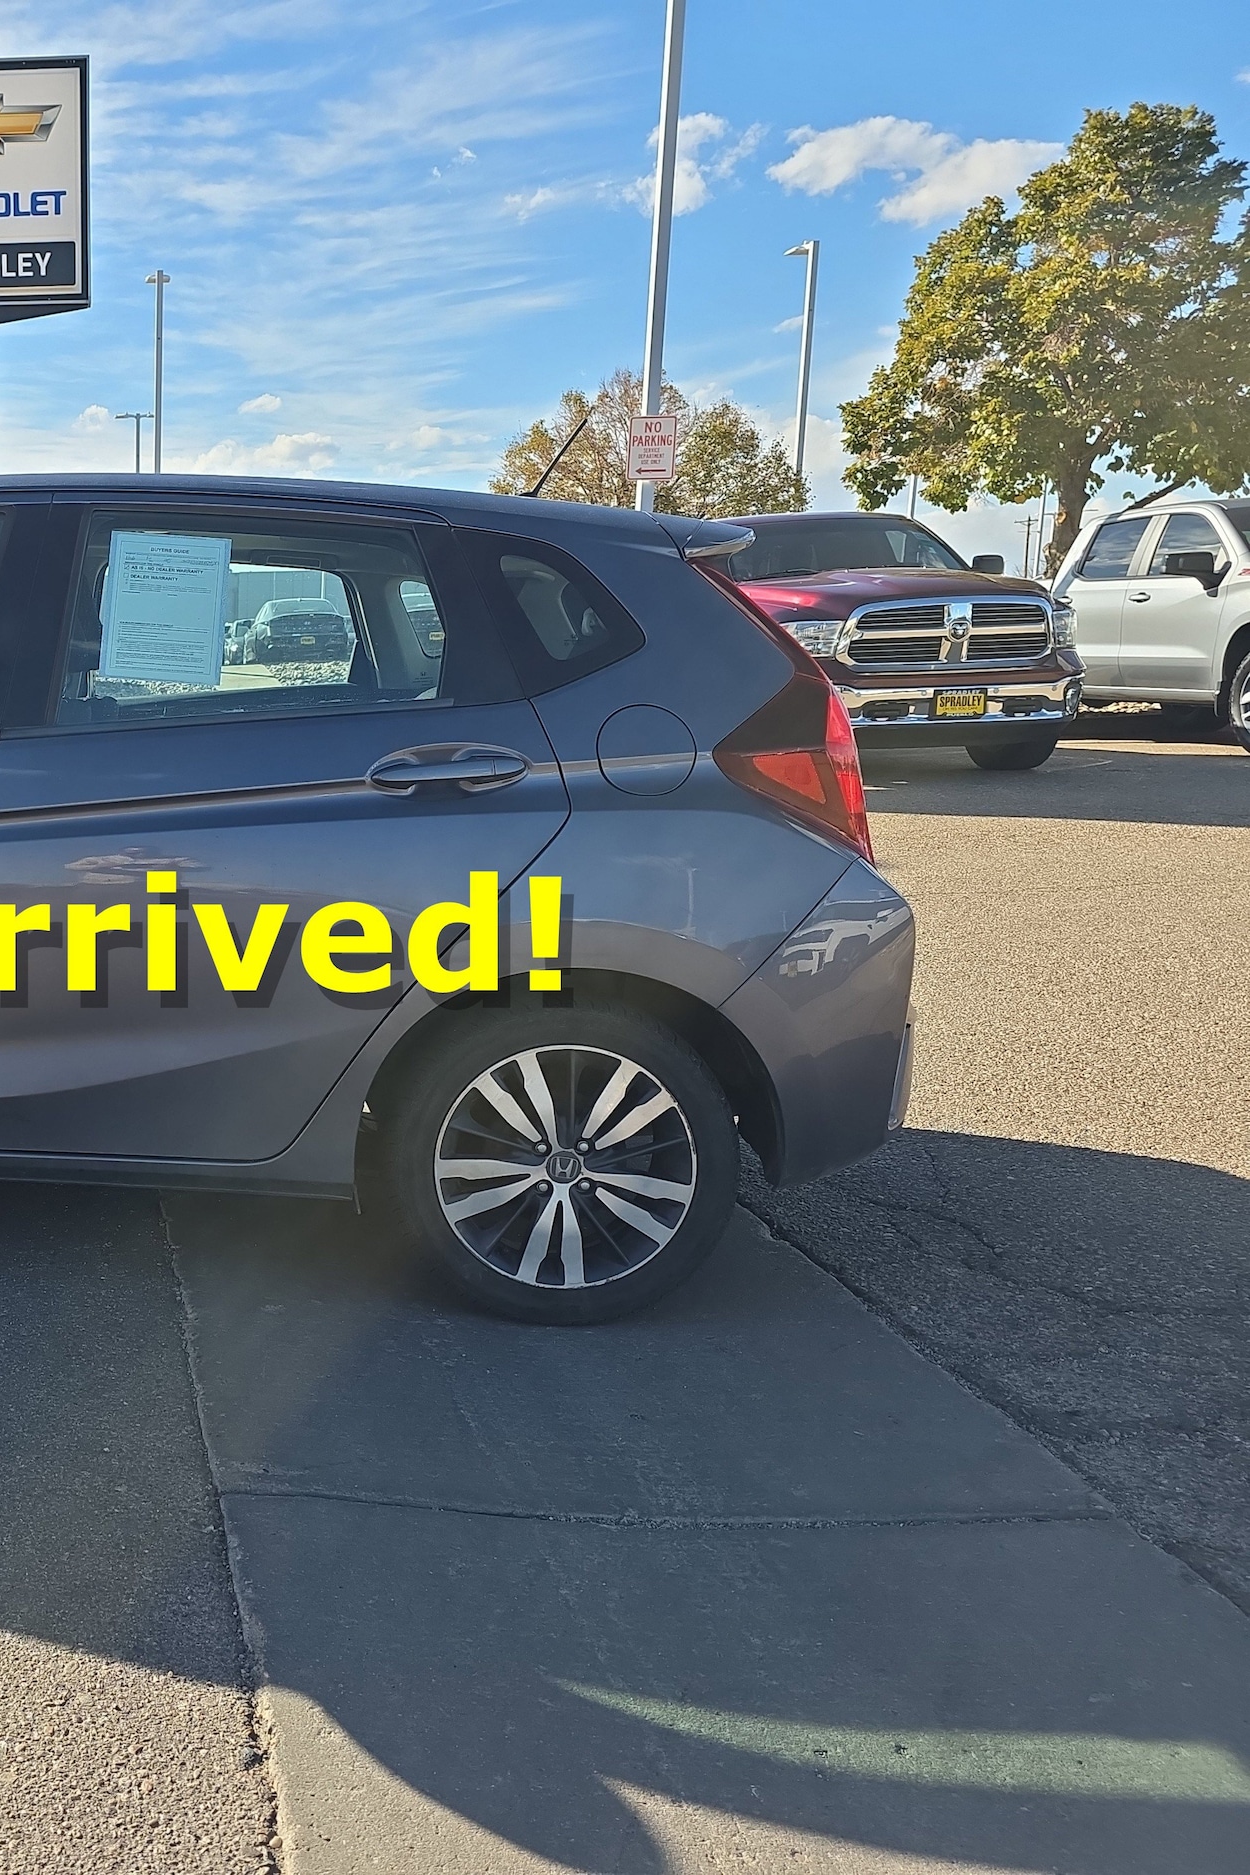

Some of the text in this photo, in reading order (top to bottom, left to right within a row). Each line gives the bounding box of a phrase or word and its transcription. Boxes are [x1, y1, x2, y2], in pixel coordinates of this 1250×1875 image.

[645, 421, 662, 433] NO
[632, 434, 673, 447] PARKING
[940, 695, 982, 707] SPRADLEY
